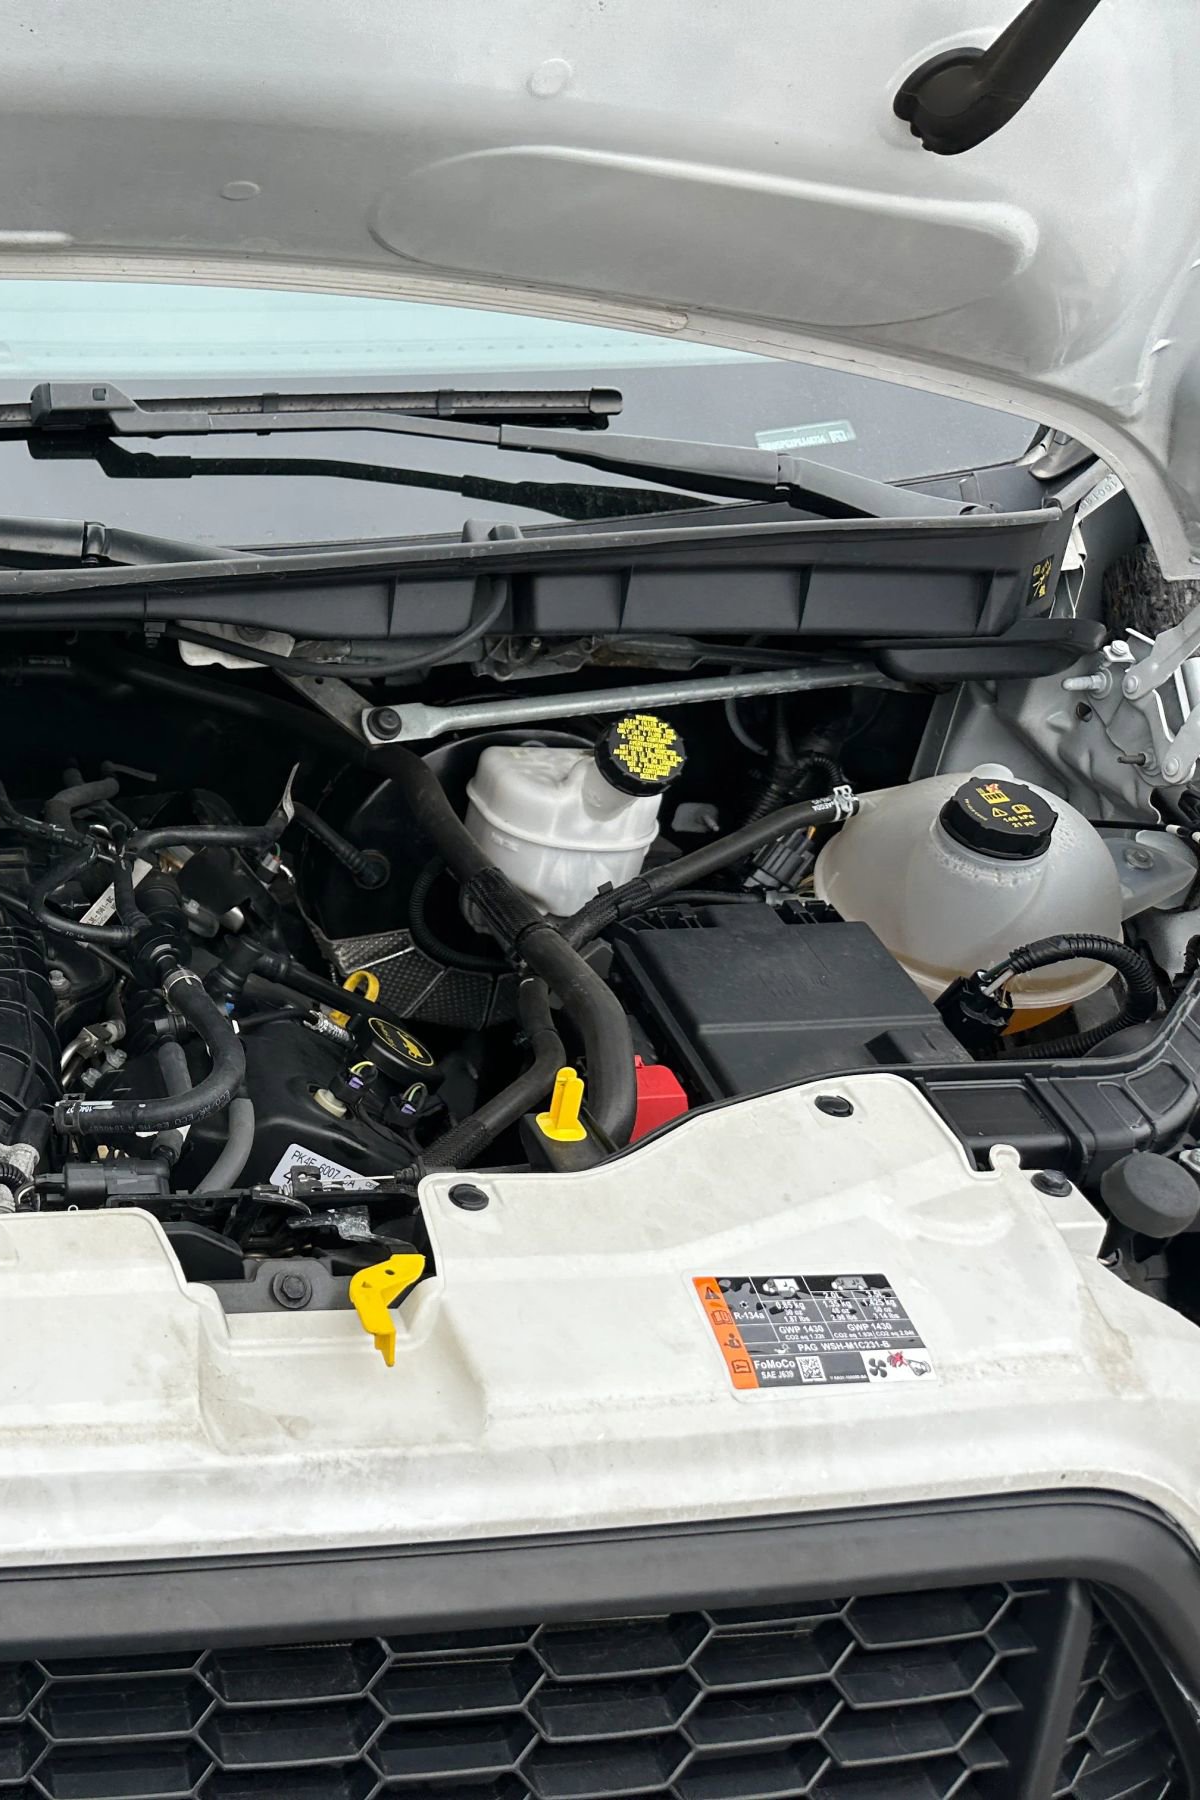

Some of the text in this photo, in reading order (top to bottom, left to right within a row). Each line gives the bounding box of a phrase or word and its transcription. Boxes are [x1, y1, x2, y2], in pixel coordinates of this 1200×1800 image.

[319, 1163, 341, 1179] 6007
[865, 1290, 885, 1298] 3.5L
[775, 1300, 806, 1310] 0.85 kg
[822, 1300, 852, 1309] 1.35 kg
[884, 1298, 897, 1307] kg
[733, 1311, 765, 1320] R-134a
[778, 1325, 825, 1334] GWP 1430
[847, 1322, 893, 1331] GWP 1430
[797, 1339, 890, 1352] PAG WSH-M1C231-B
[754, 1359, 796, 1369] FoMoCo
[761, 1371, 778, 1379] SAE
